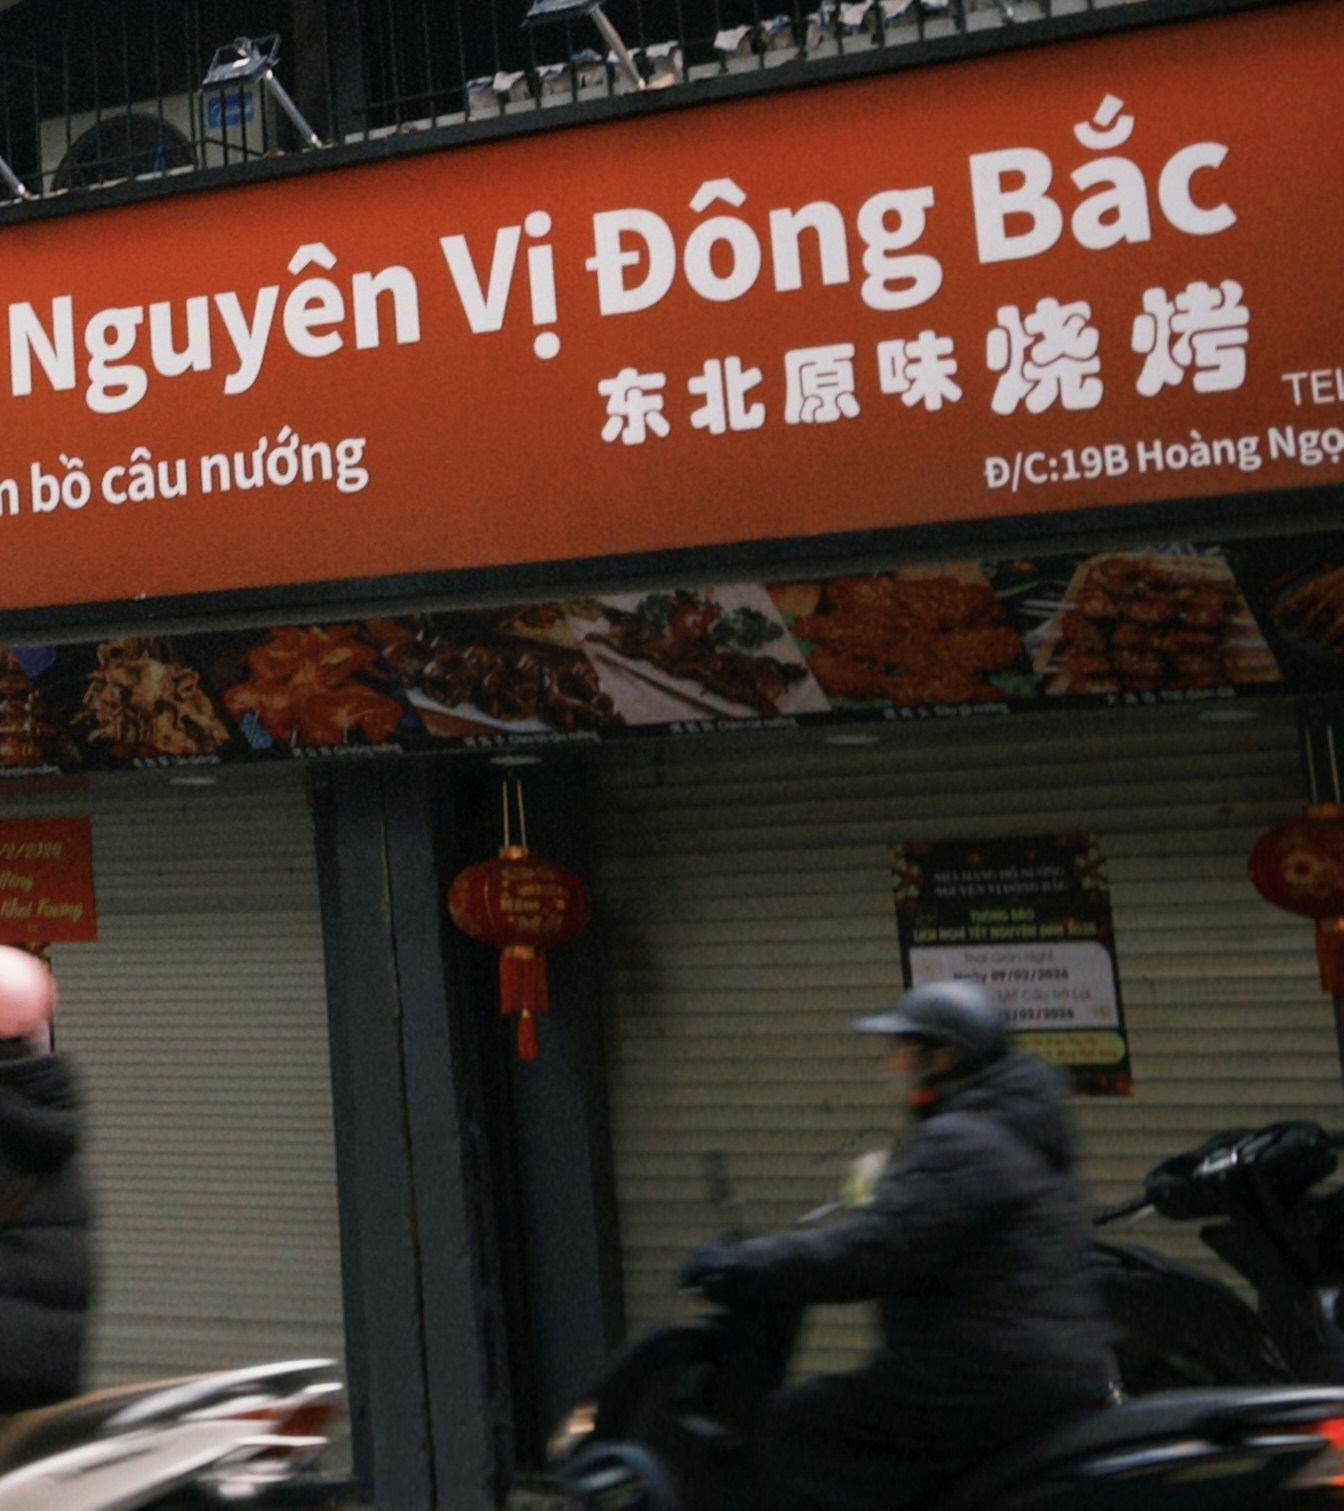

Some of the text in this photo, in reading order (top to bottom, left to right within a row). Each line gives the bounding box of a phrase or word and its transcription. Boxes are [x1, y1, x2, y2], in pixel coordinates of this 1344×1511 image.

[9, 242, 420, 413] Nguyên
[440, 211, 560, 359] Vị
[585, 178, 943, 316] Đông
[969, 94, 1237, 264] Bắc
[598, 279, 1250, 445] 东北原味烧烤
[30, 445, 91, 512] bồ
[102, 446, 187, 504] câu
[200, 425, 369, 494] nướng
[983, 443, 1129, 493] Đ/C:19B
[1136, 429, 1262, 473] Hoàng
